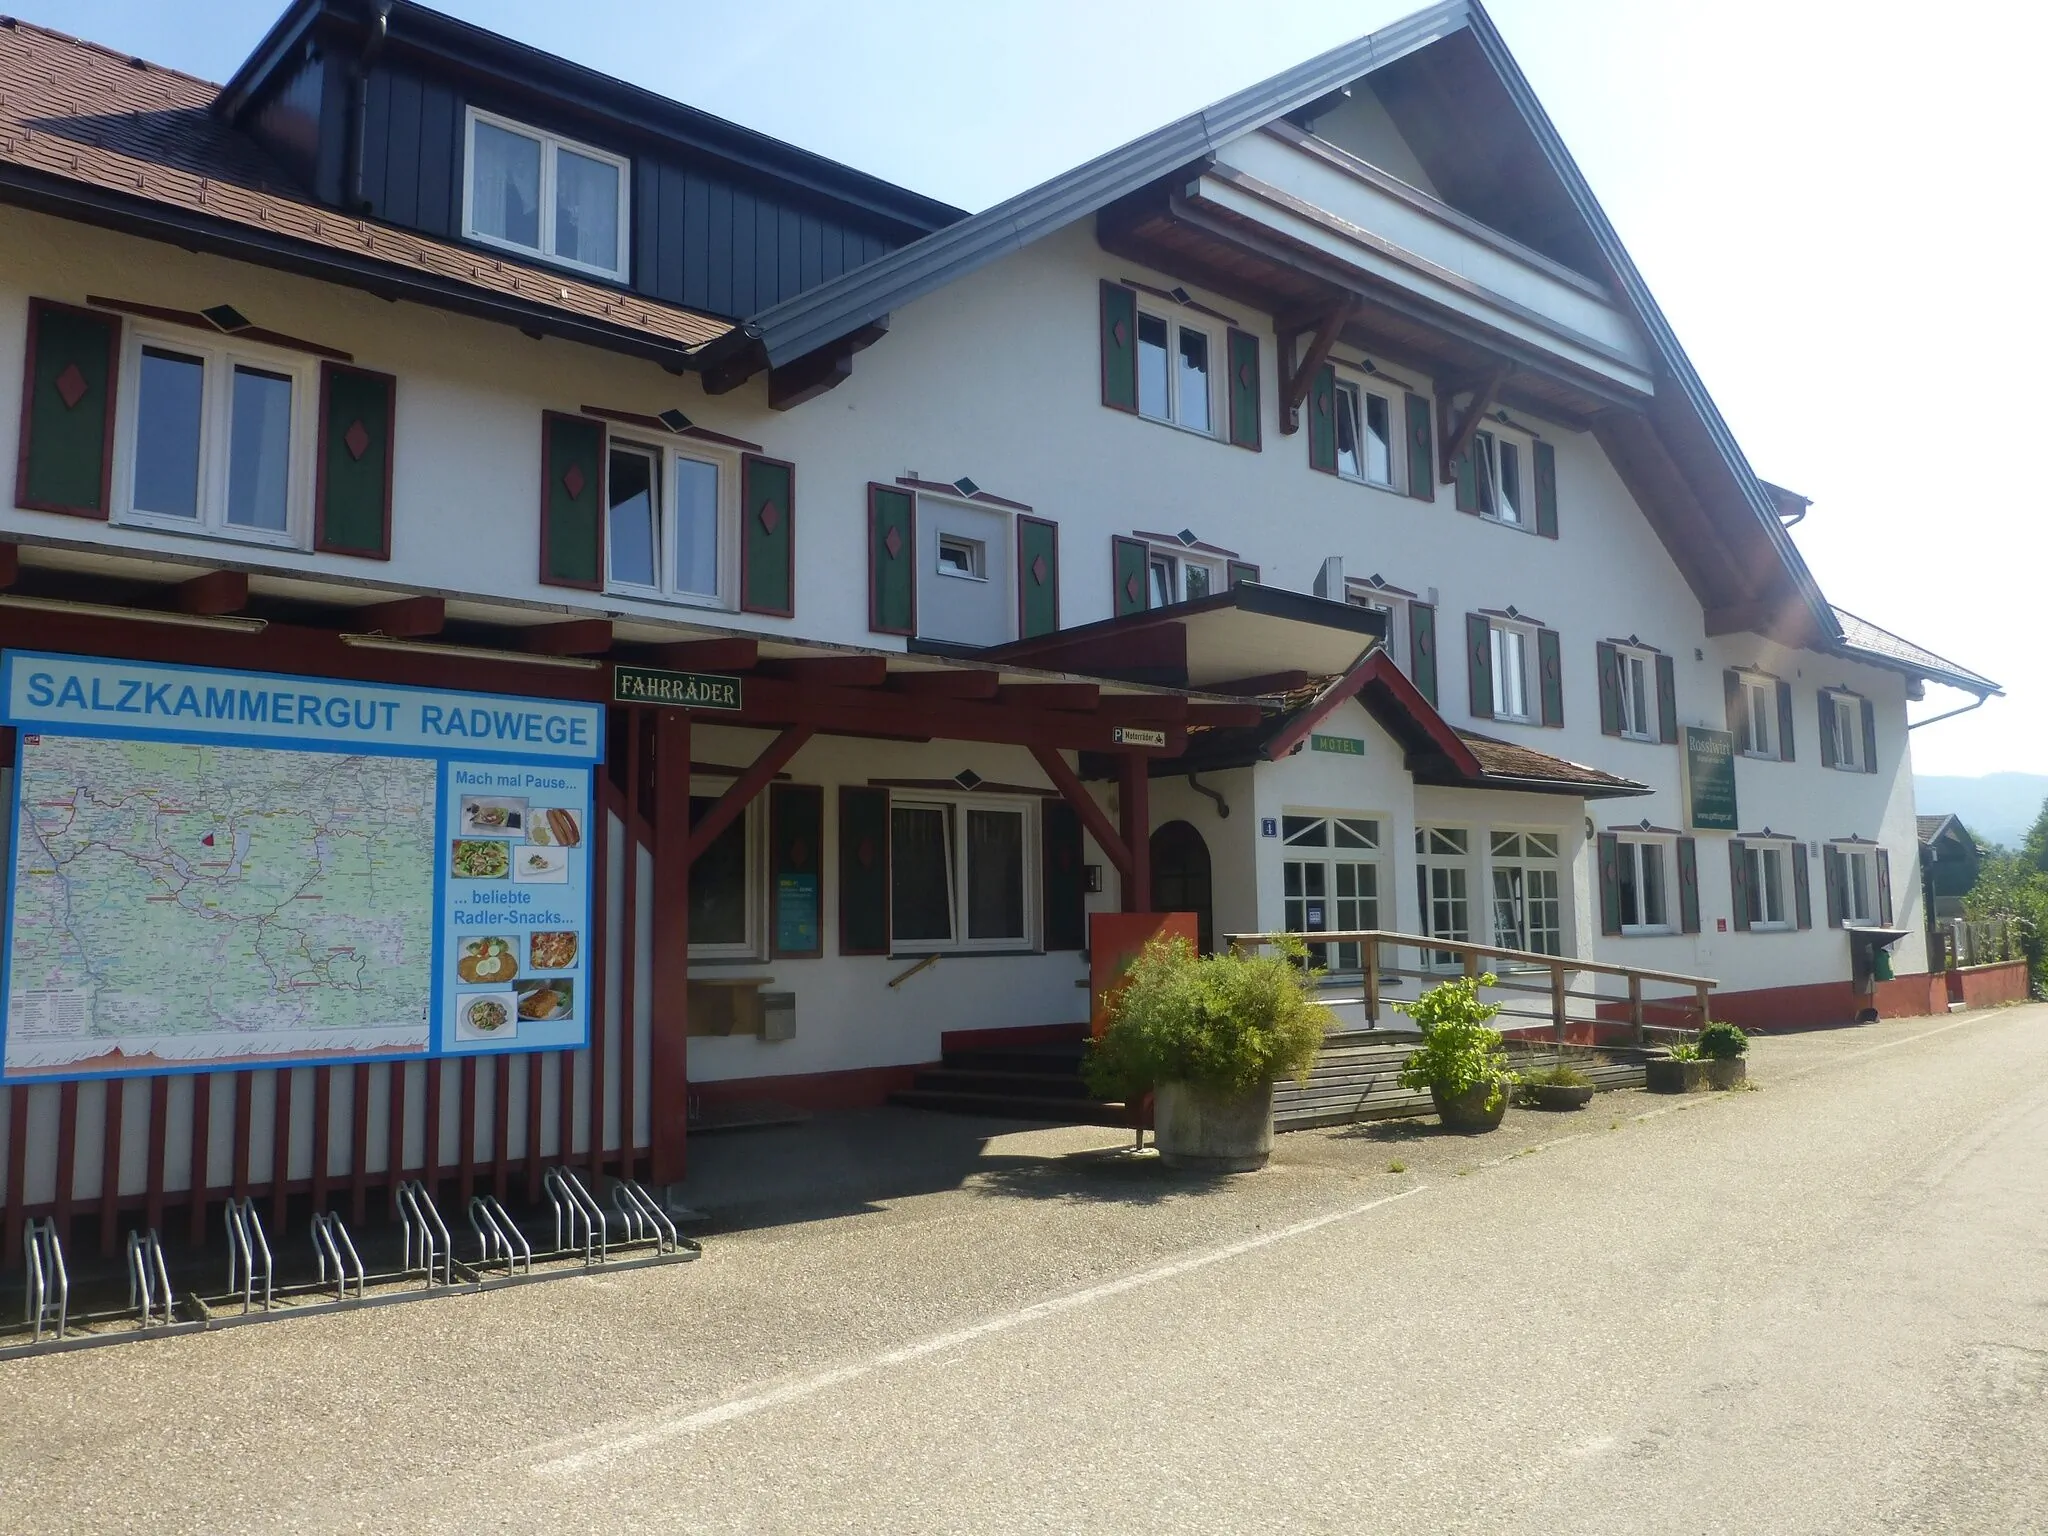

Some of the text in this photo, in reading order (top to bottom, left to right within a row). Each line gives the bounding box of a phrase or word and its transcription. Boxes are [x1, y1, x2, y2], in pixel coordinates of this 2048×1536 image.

[621, 675, 735, 705] FAHRRÄDER
[26, 672, 587, 746] SALZKAMMERGUT RADWEGE
[1114, 728, 1154, 742] P Motorräder
[1320, 738, 1357, 753] MOTEL
[1688, 735, 1731, 756] Rosslwirt
[455, 770, 577, 790] Mach mal Pause...
[472, 889, 531, 905] beliebte
[453, 909, 574, 925] Radler-Snacks...
